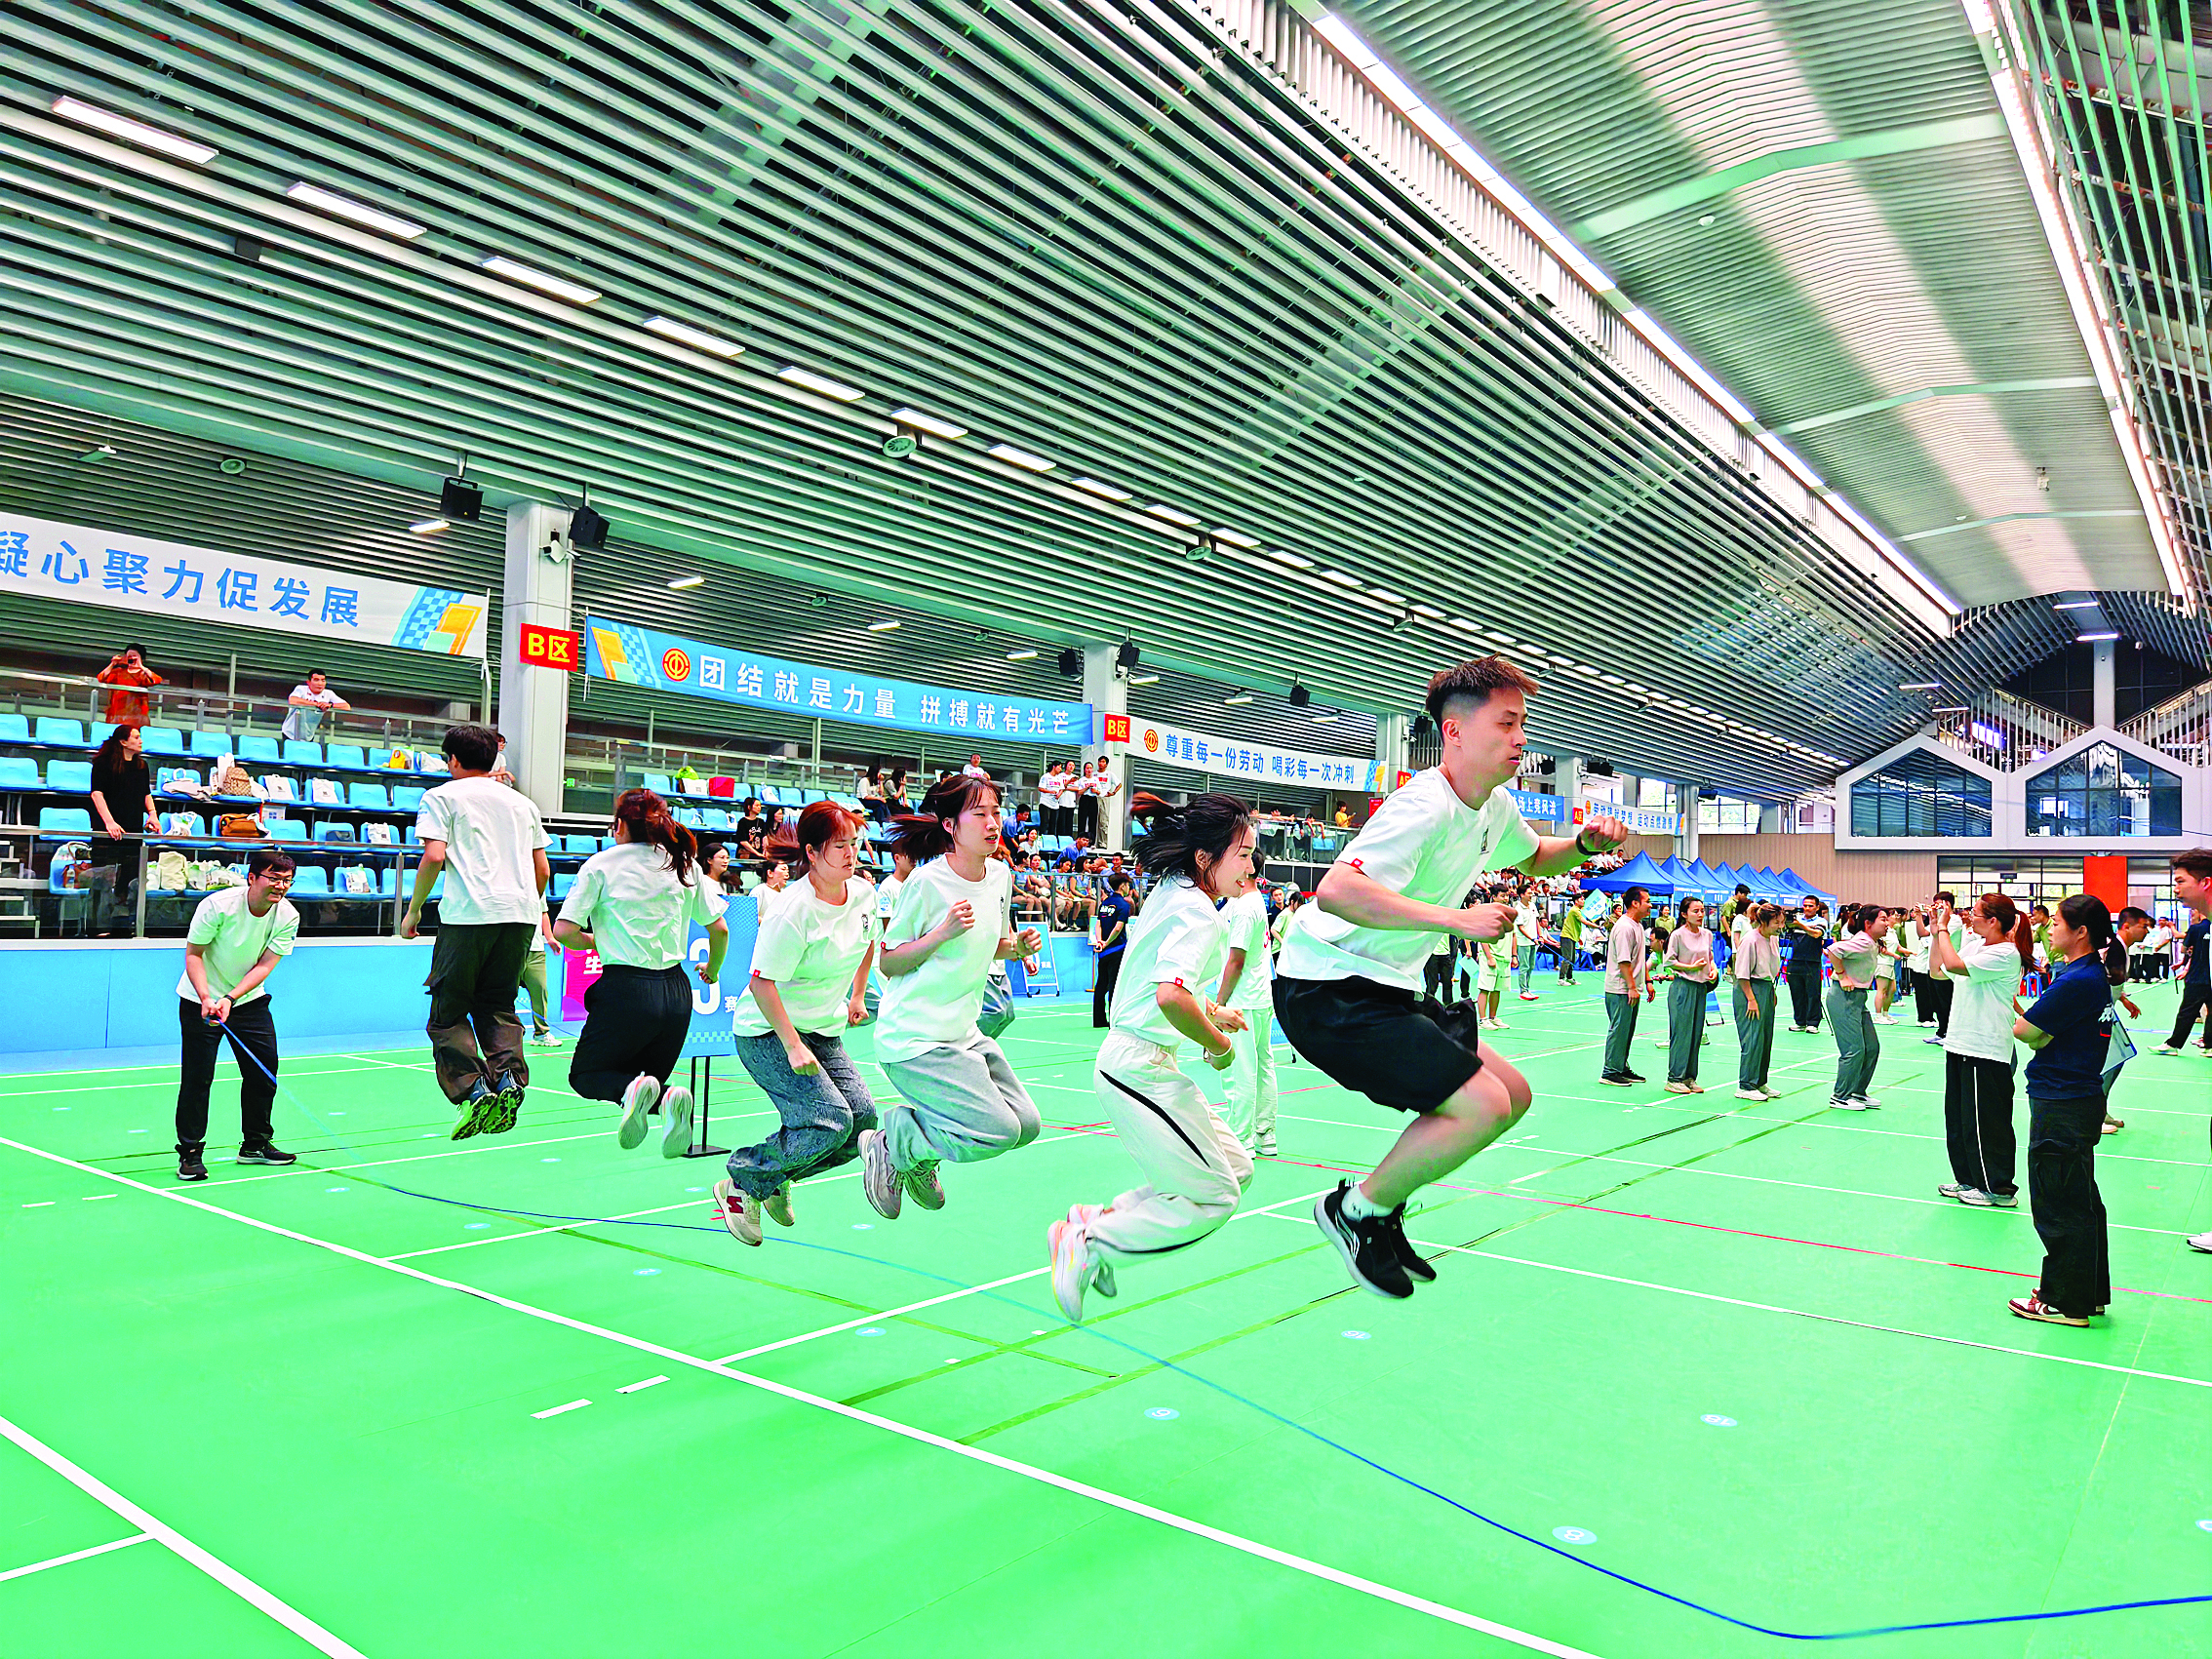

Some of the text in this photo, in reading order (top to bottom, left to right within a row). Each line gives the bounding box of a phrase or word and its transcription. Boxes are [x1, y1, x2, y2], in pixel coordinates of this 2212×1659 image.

[0, 531, 359, 627] 凝心聚力促发展
[527, 632, 572, 663] B区
[698, 653, 1070, 735] 团结就是力量 拼搏就有光芒
[1107, 719, 1128, 739] B区
[1165, 733, 1355, 785] 尊重每一份劳动 喝彩每一次冲刺
[1514, 795, 1557, 816] 场上竞风流
[1563, 1529, 1585, 1541] 8
